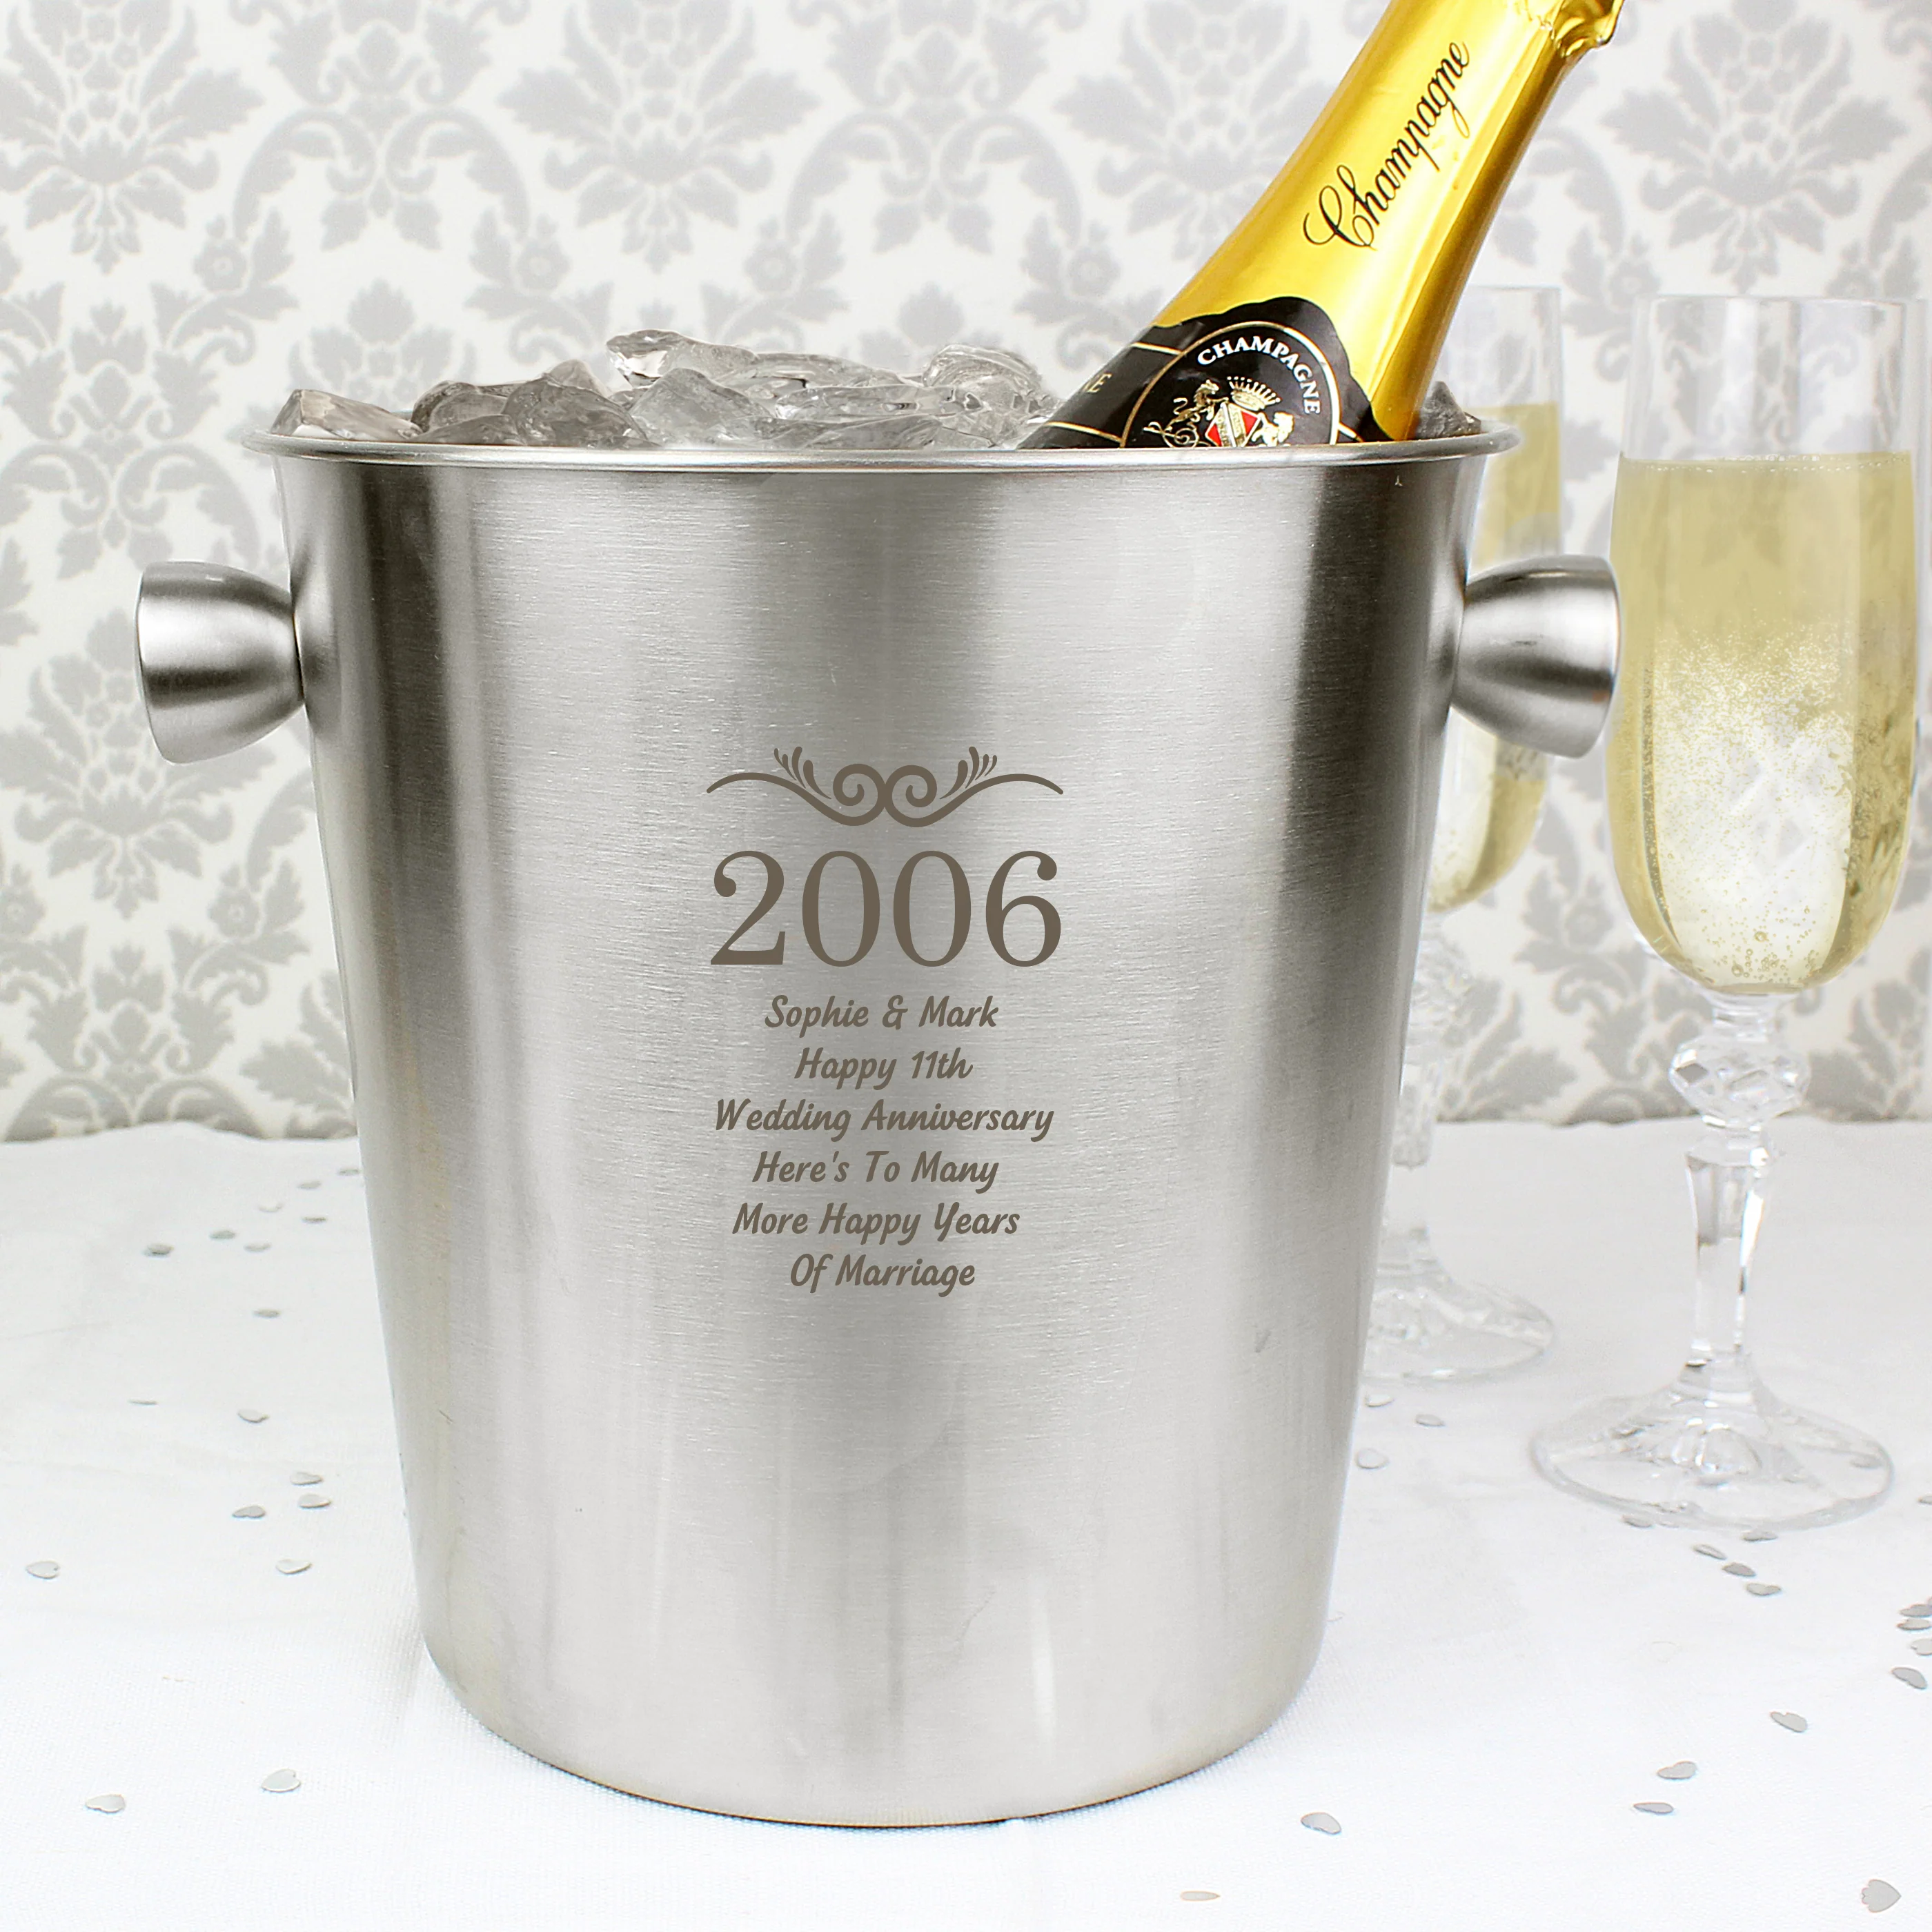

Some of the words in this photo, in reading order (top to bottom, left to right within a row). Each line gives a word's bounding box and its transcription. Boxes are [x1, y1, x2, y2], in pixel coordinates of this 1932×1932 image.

[1303, 40, 1470, 250] Champagne
[1197, 335, 1321, 415] CHAMPAGNE
[711, 850, 1061, 967] 2006
[764, 994, 869, 1038] Sophie
[882, 994, 909, 1030] &
[918, 995, 999, 1027] Mark
[793, 1047, 897, 1091] Happy
[911, 1047, 974, 1079] 11th
[716, 1098, 851, 1143] Wedding
[860, 1098, 1055, 1143] Anniversary
[751, 1150, 850, 1183] Here's
[865, 1150, 900, 1183] To
[911, 1150, 1000, 1194] Many
[731, 1202, 808, 1234] More
[818, 1202, 922, 1246] Happy
[934, 1201, 1021, 1242] Years
[790, 1253, 834, 1294] Of
[835, 1254, 976, 1298] Marriage
